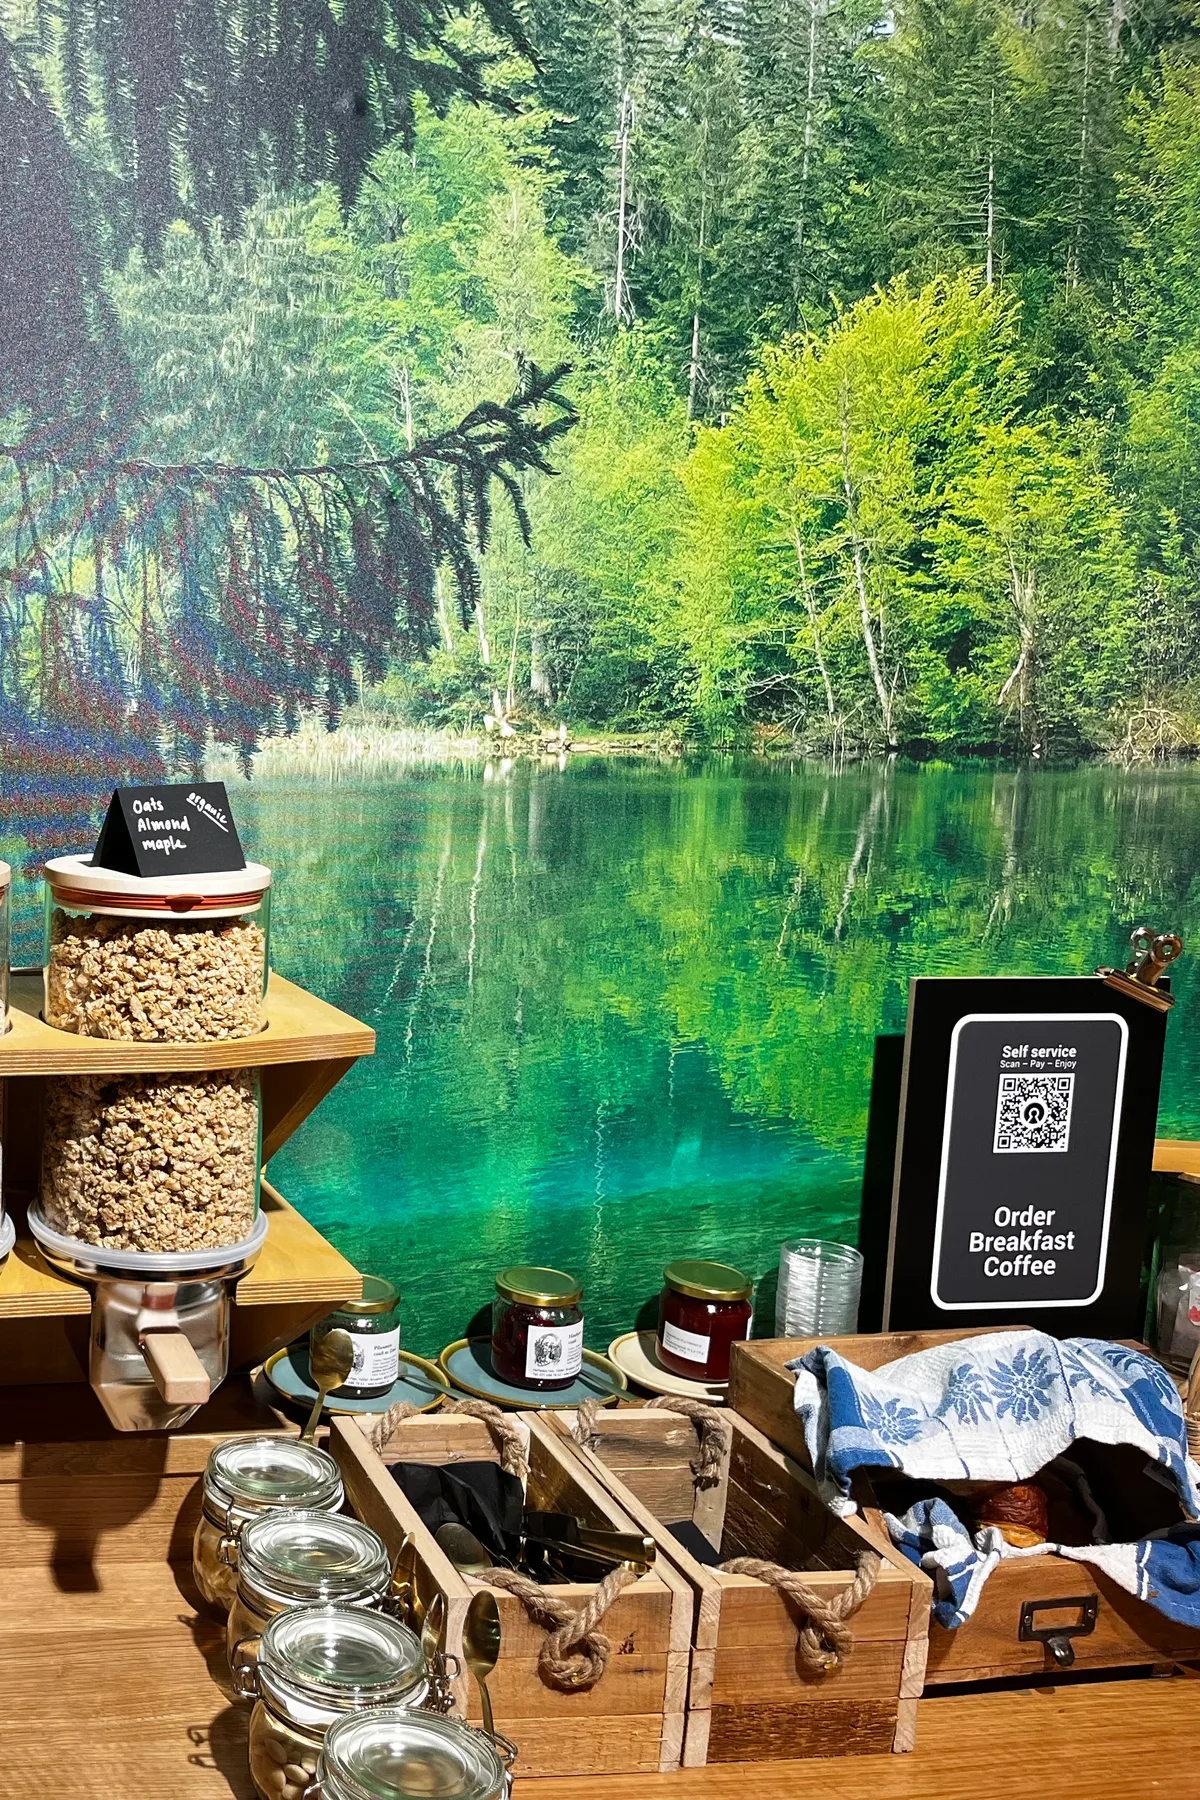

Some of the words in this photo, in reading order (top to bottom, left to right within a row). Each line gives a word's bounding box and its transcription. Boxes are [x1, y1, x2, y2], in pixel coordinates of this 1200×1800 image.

[132, 797, 164, 815] Oats
[137, 815, 191, 832] Almond
[141, 835, 188, 856] maple
[1001, 1044, 1030, 1059] Self
[1030, 1044, 1077, 1058] service
[999, 1059, 1021, 1069] Scan
[1029, 1059, 1046, 1070] Pay
[1054, 1059, 1077, 1070] Enjoy
[994, 1204, 1056, 1228] Order
[968, 1228, 1076, 1253] Breakfast
[983, 1253, 1057, 1277] Coffee
